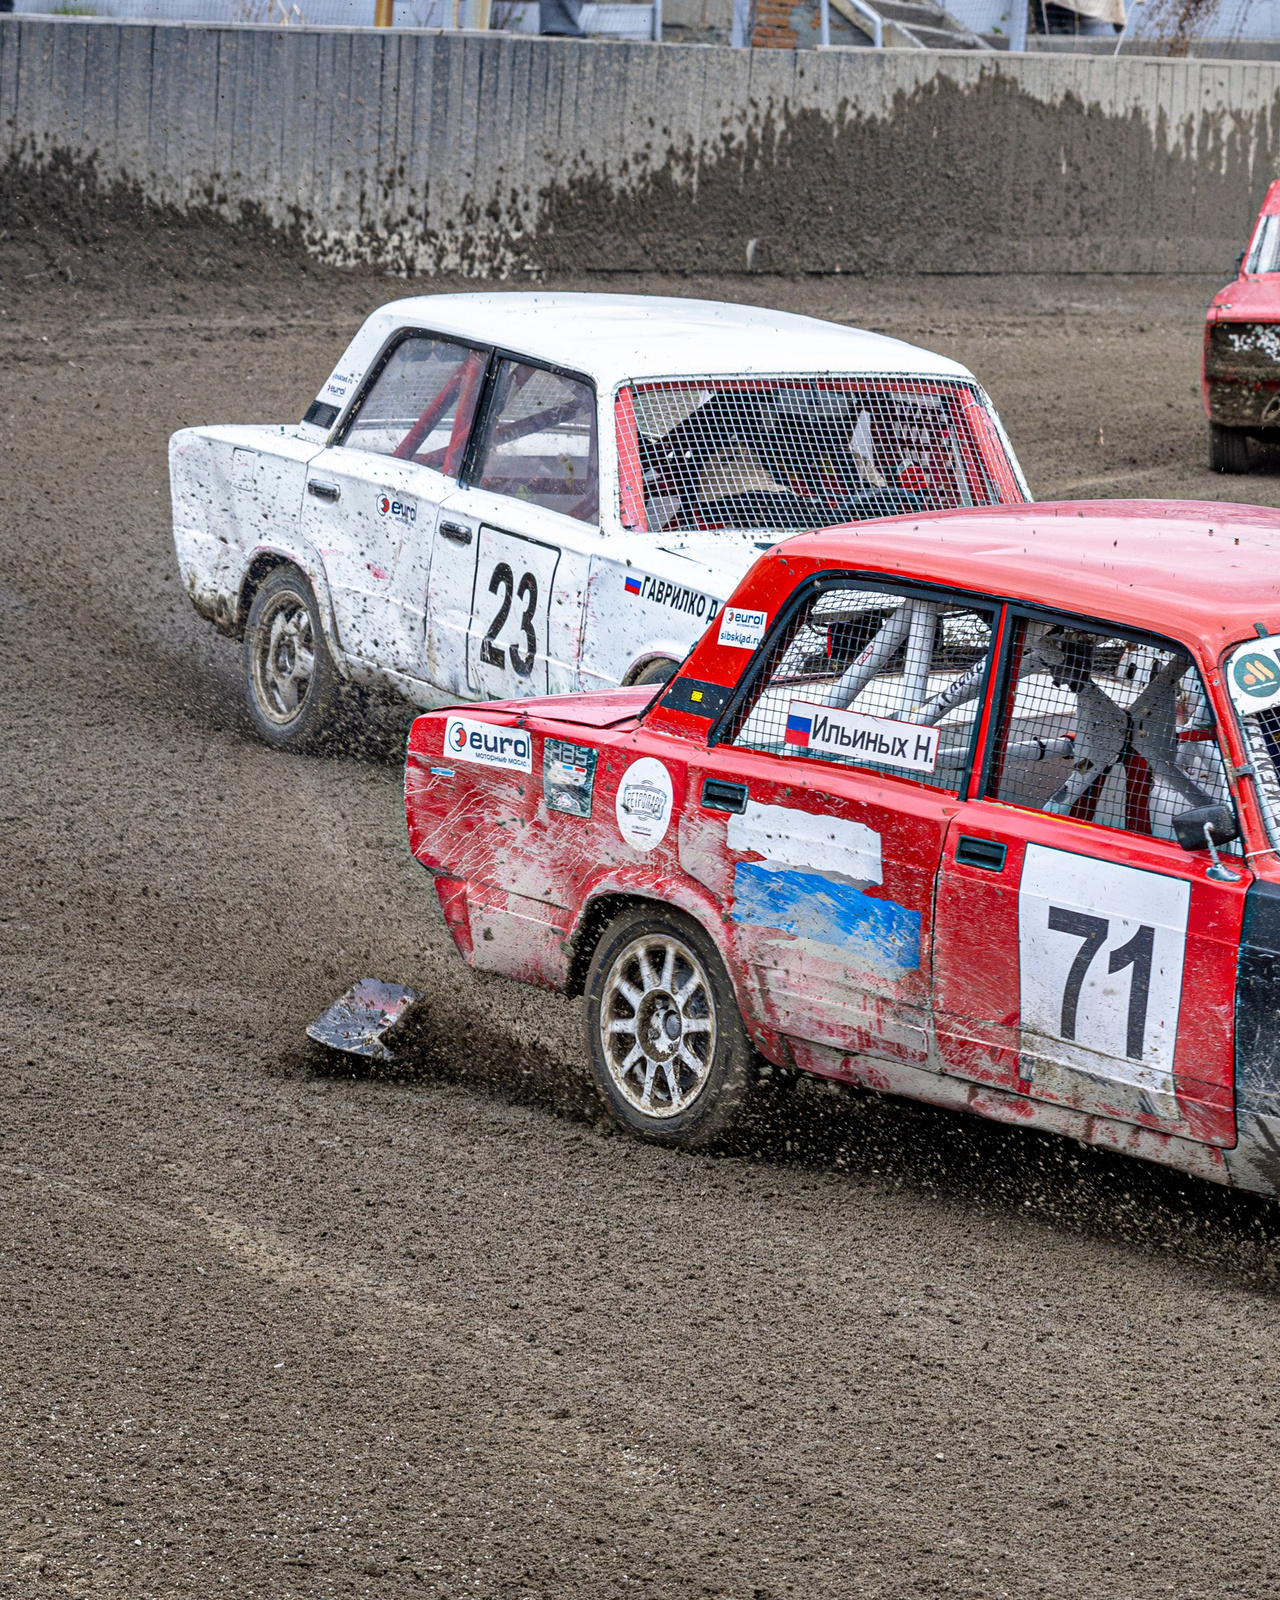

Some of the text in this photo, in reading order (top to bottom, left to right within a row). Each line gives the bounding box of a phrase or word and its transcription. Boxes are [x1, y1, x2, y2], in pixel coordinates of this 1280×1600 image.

[642, 576, 706, 617] ГАВРИЛКО
[480, 562, 538, 678] 23
[720, 630, 761, 646] sibsklad.ru
[734, 612, 765, 626] eurol
[470, 731, 530, 760] eurol
[811, 713, 933, 764] Ильиных Н.
[1048, 905, 1155, 1061] 71
